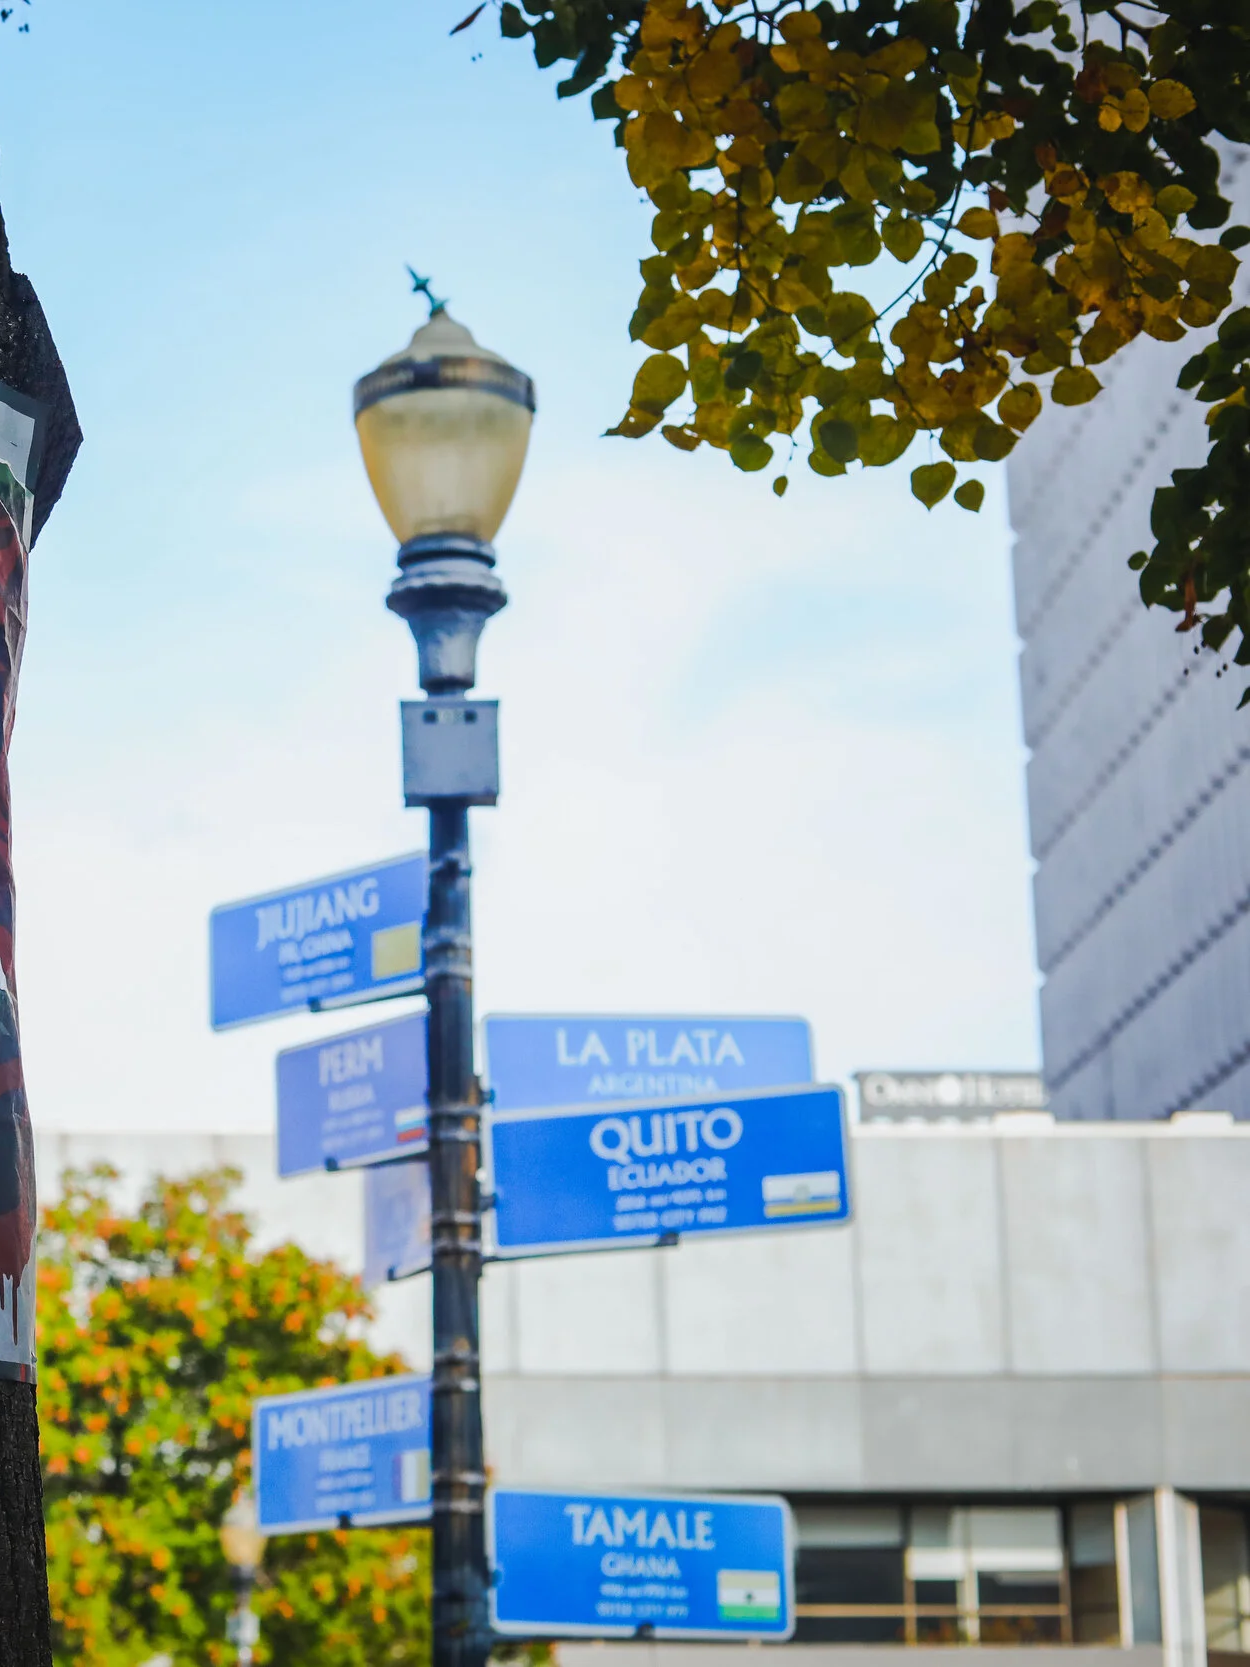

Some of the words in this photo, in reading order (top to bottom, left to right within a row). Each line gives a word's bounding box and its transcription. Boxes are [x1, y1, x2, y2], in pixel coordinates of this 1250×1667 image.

[256, 879, 379, 950] JIUJIANG
[556, 1028, 610, 1067] LA
[627, 1028, 745, 1067] PLATA
[588, 1072, 718, 1096] ARGENTINA
[589, 1107, 744, 1163] QUITO
[607, 1157, 727, 1191] ECUADOR
[267, 1391, 423, 1450] MONTPELLIER
[564, 1503, 714, 1550] TAMALE
[601, 1552, 681, 1579] GHANA
